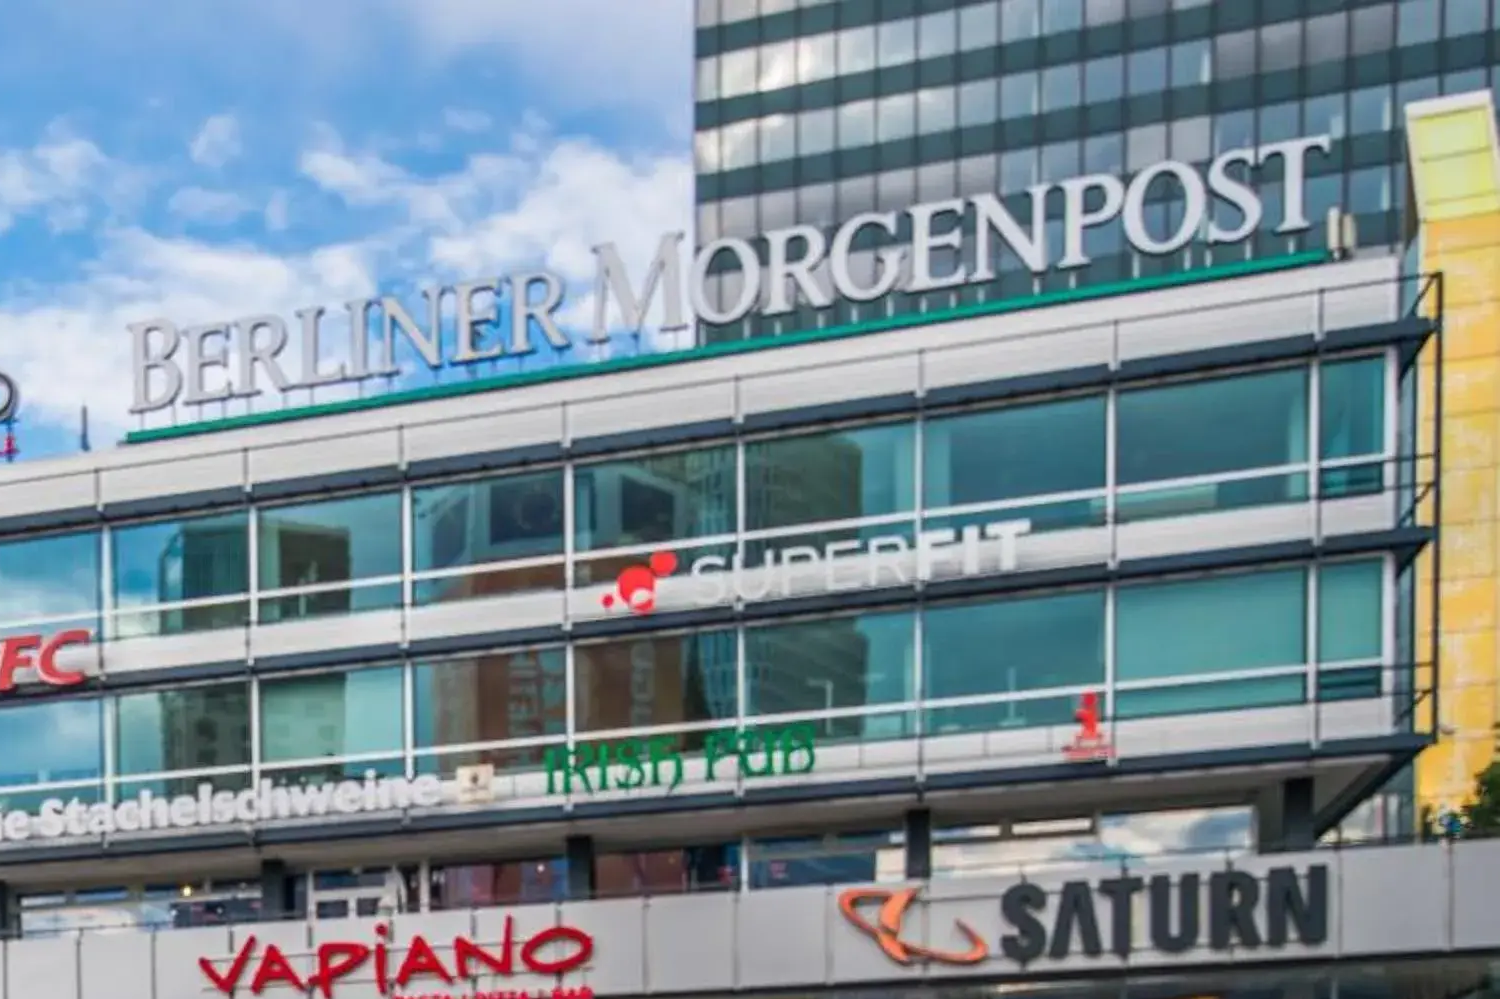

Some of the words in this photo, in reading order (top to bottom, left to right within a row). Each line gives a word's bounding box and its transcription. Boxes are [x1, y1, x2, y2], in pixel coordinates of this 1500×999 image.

[126, 269, 571, 415] BERLINER
[586, 133, 1333, 344] MORGENPOST
[690, 518, 1032, 603] SUPERFIT
[543, 732, 684, 797] IRISH
[703, 720, 819, 783] PUB
[38, 768, 445, 838] Stachelschweine
[1000, 863, 1330, 968] SATURN
